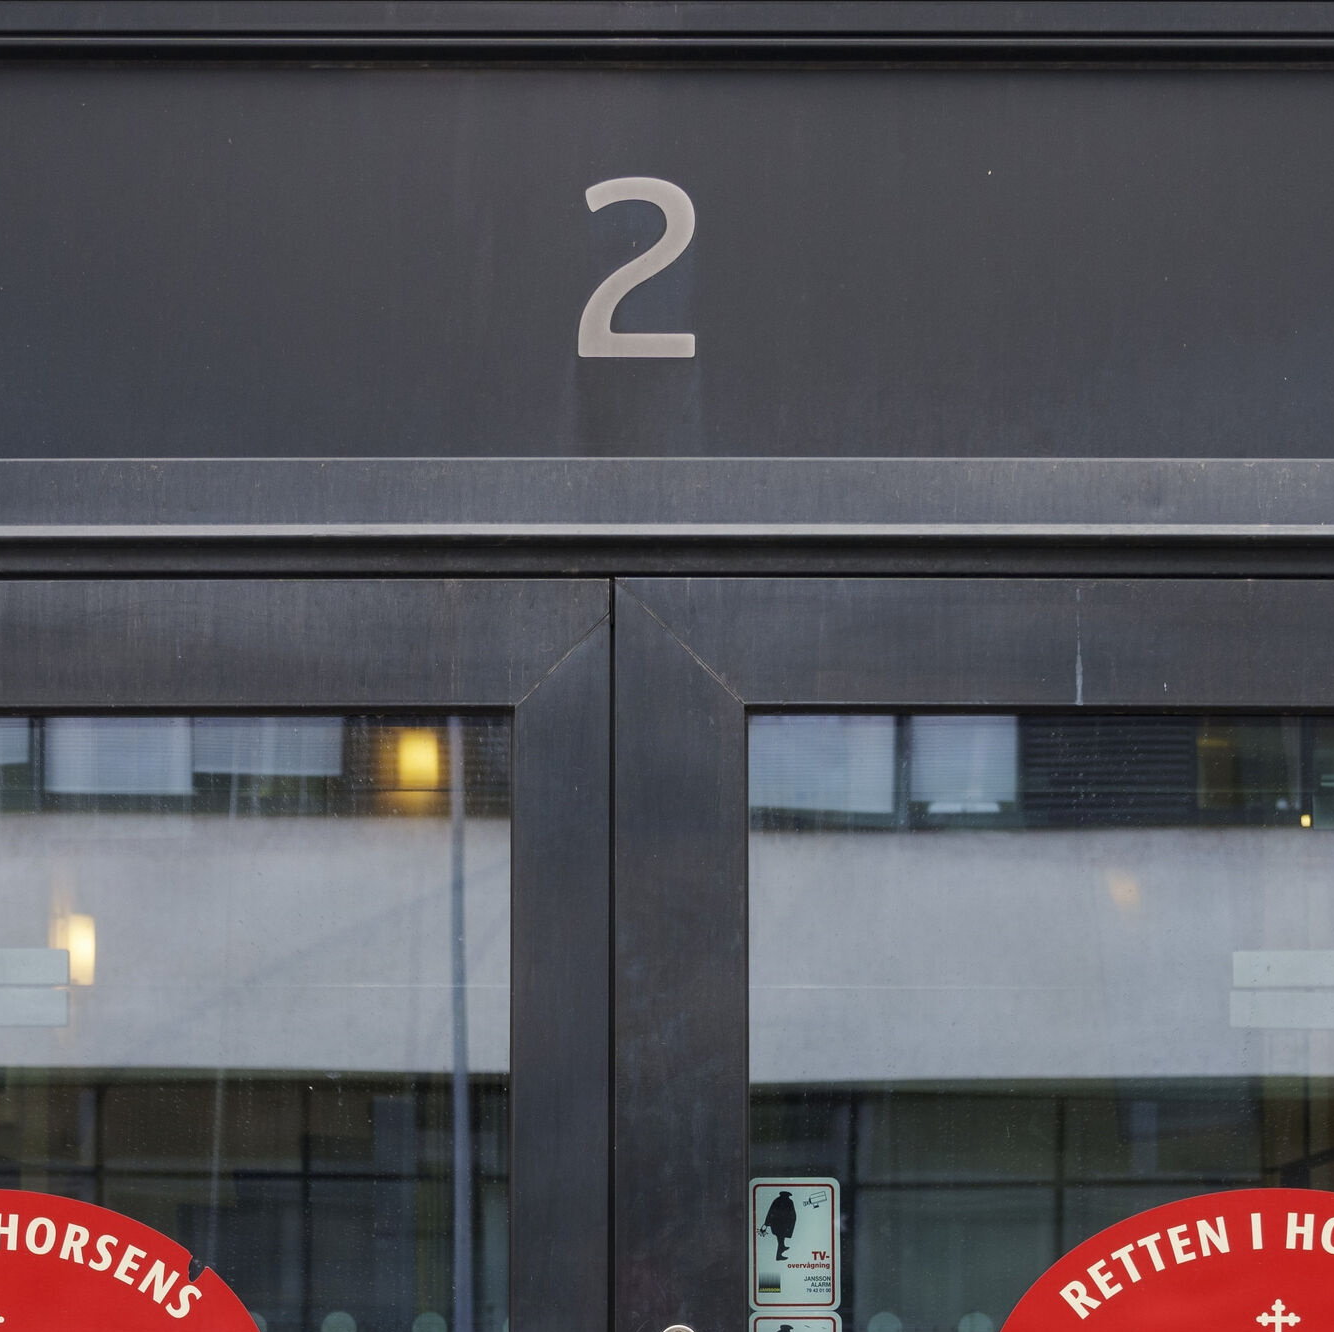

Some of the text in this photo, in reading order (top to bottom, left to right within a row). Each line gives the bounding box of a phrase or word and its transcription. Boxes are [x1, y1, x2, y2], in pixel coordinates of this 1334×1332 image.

[578, 177, 695, 358] 2
[787, 1261, 830, 1270] overvågning
[811, 1251, 830, 1261] TV-
[1059, 1215, 1230, 1320] RETTEN
[1250, 1212, 1263, 1250] I
